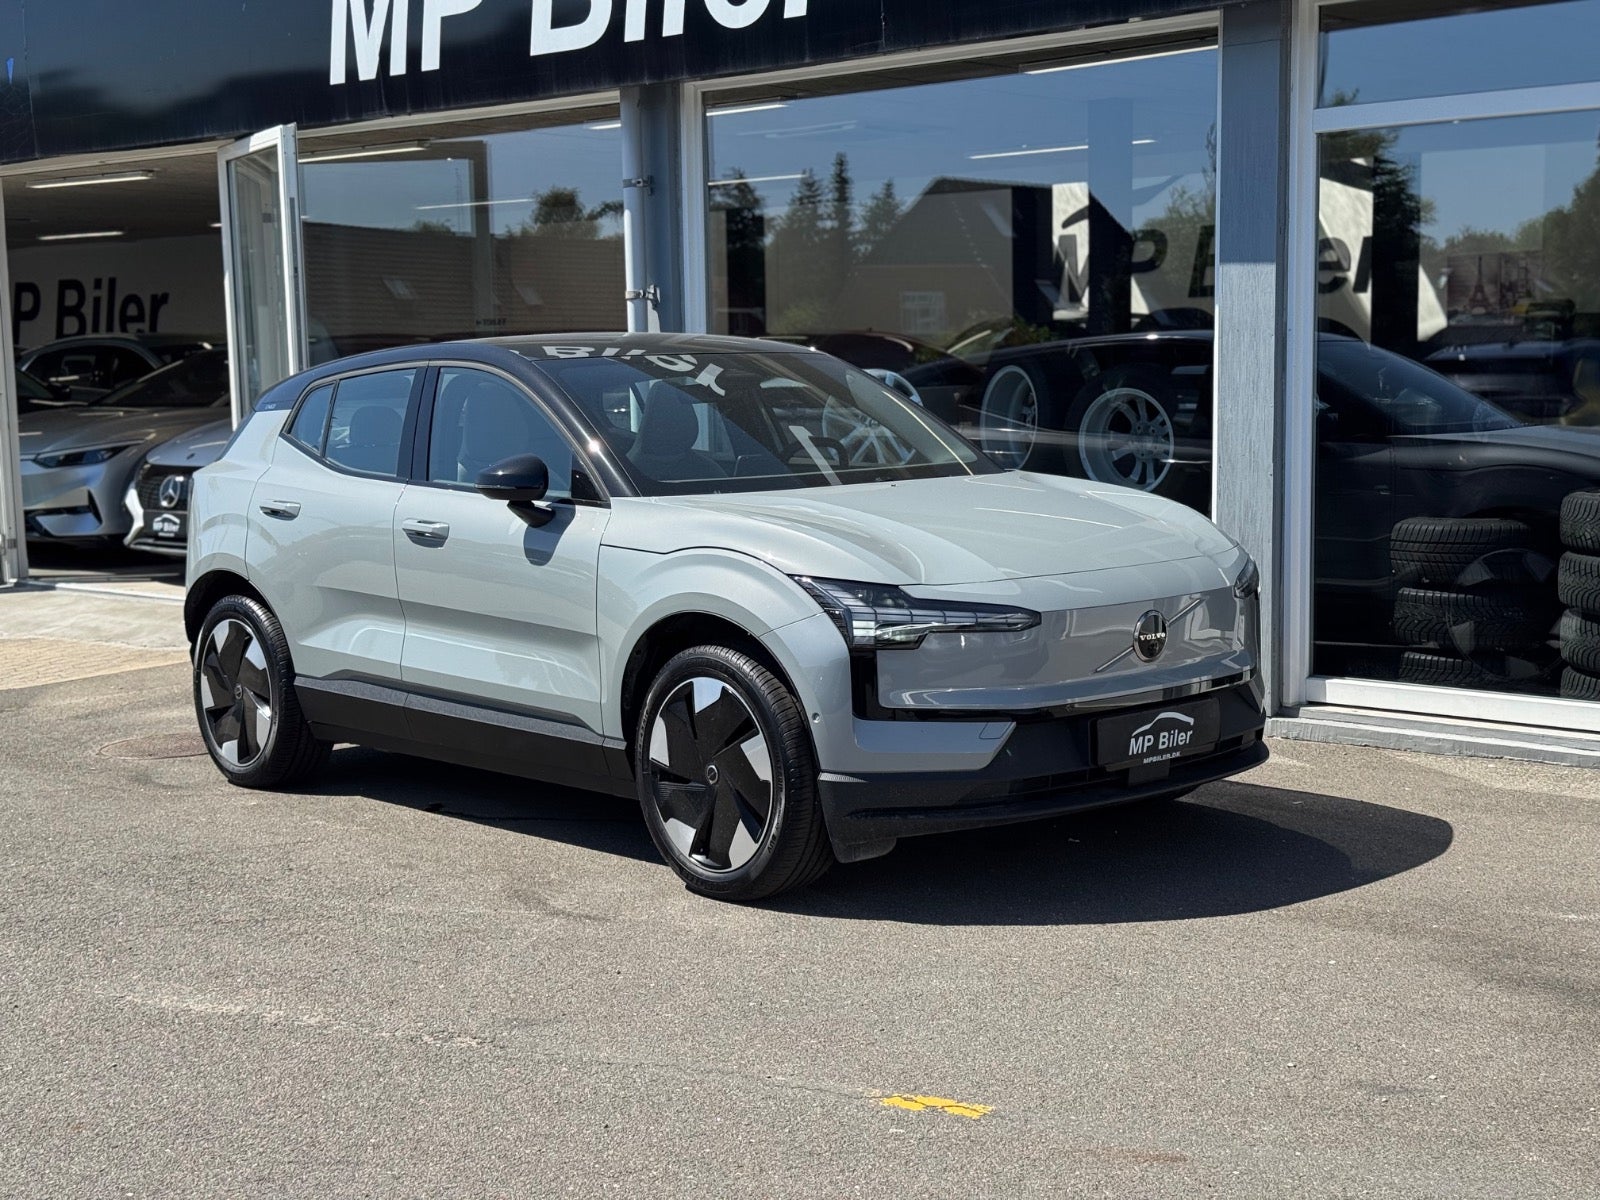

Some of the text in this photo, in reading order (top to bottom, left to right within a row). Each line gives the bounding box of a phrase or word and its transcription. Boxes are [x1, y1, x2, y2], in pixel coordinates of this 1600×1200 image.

[56, 277, 170, 340] Biler
[1139, 632, 1166, 641] VOLVO
[1128, 729, 1194, 756] MP Biler
